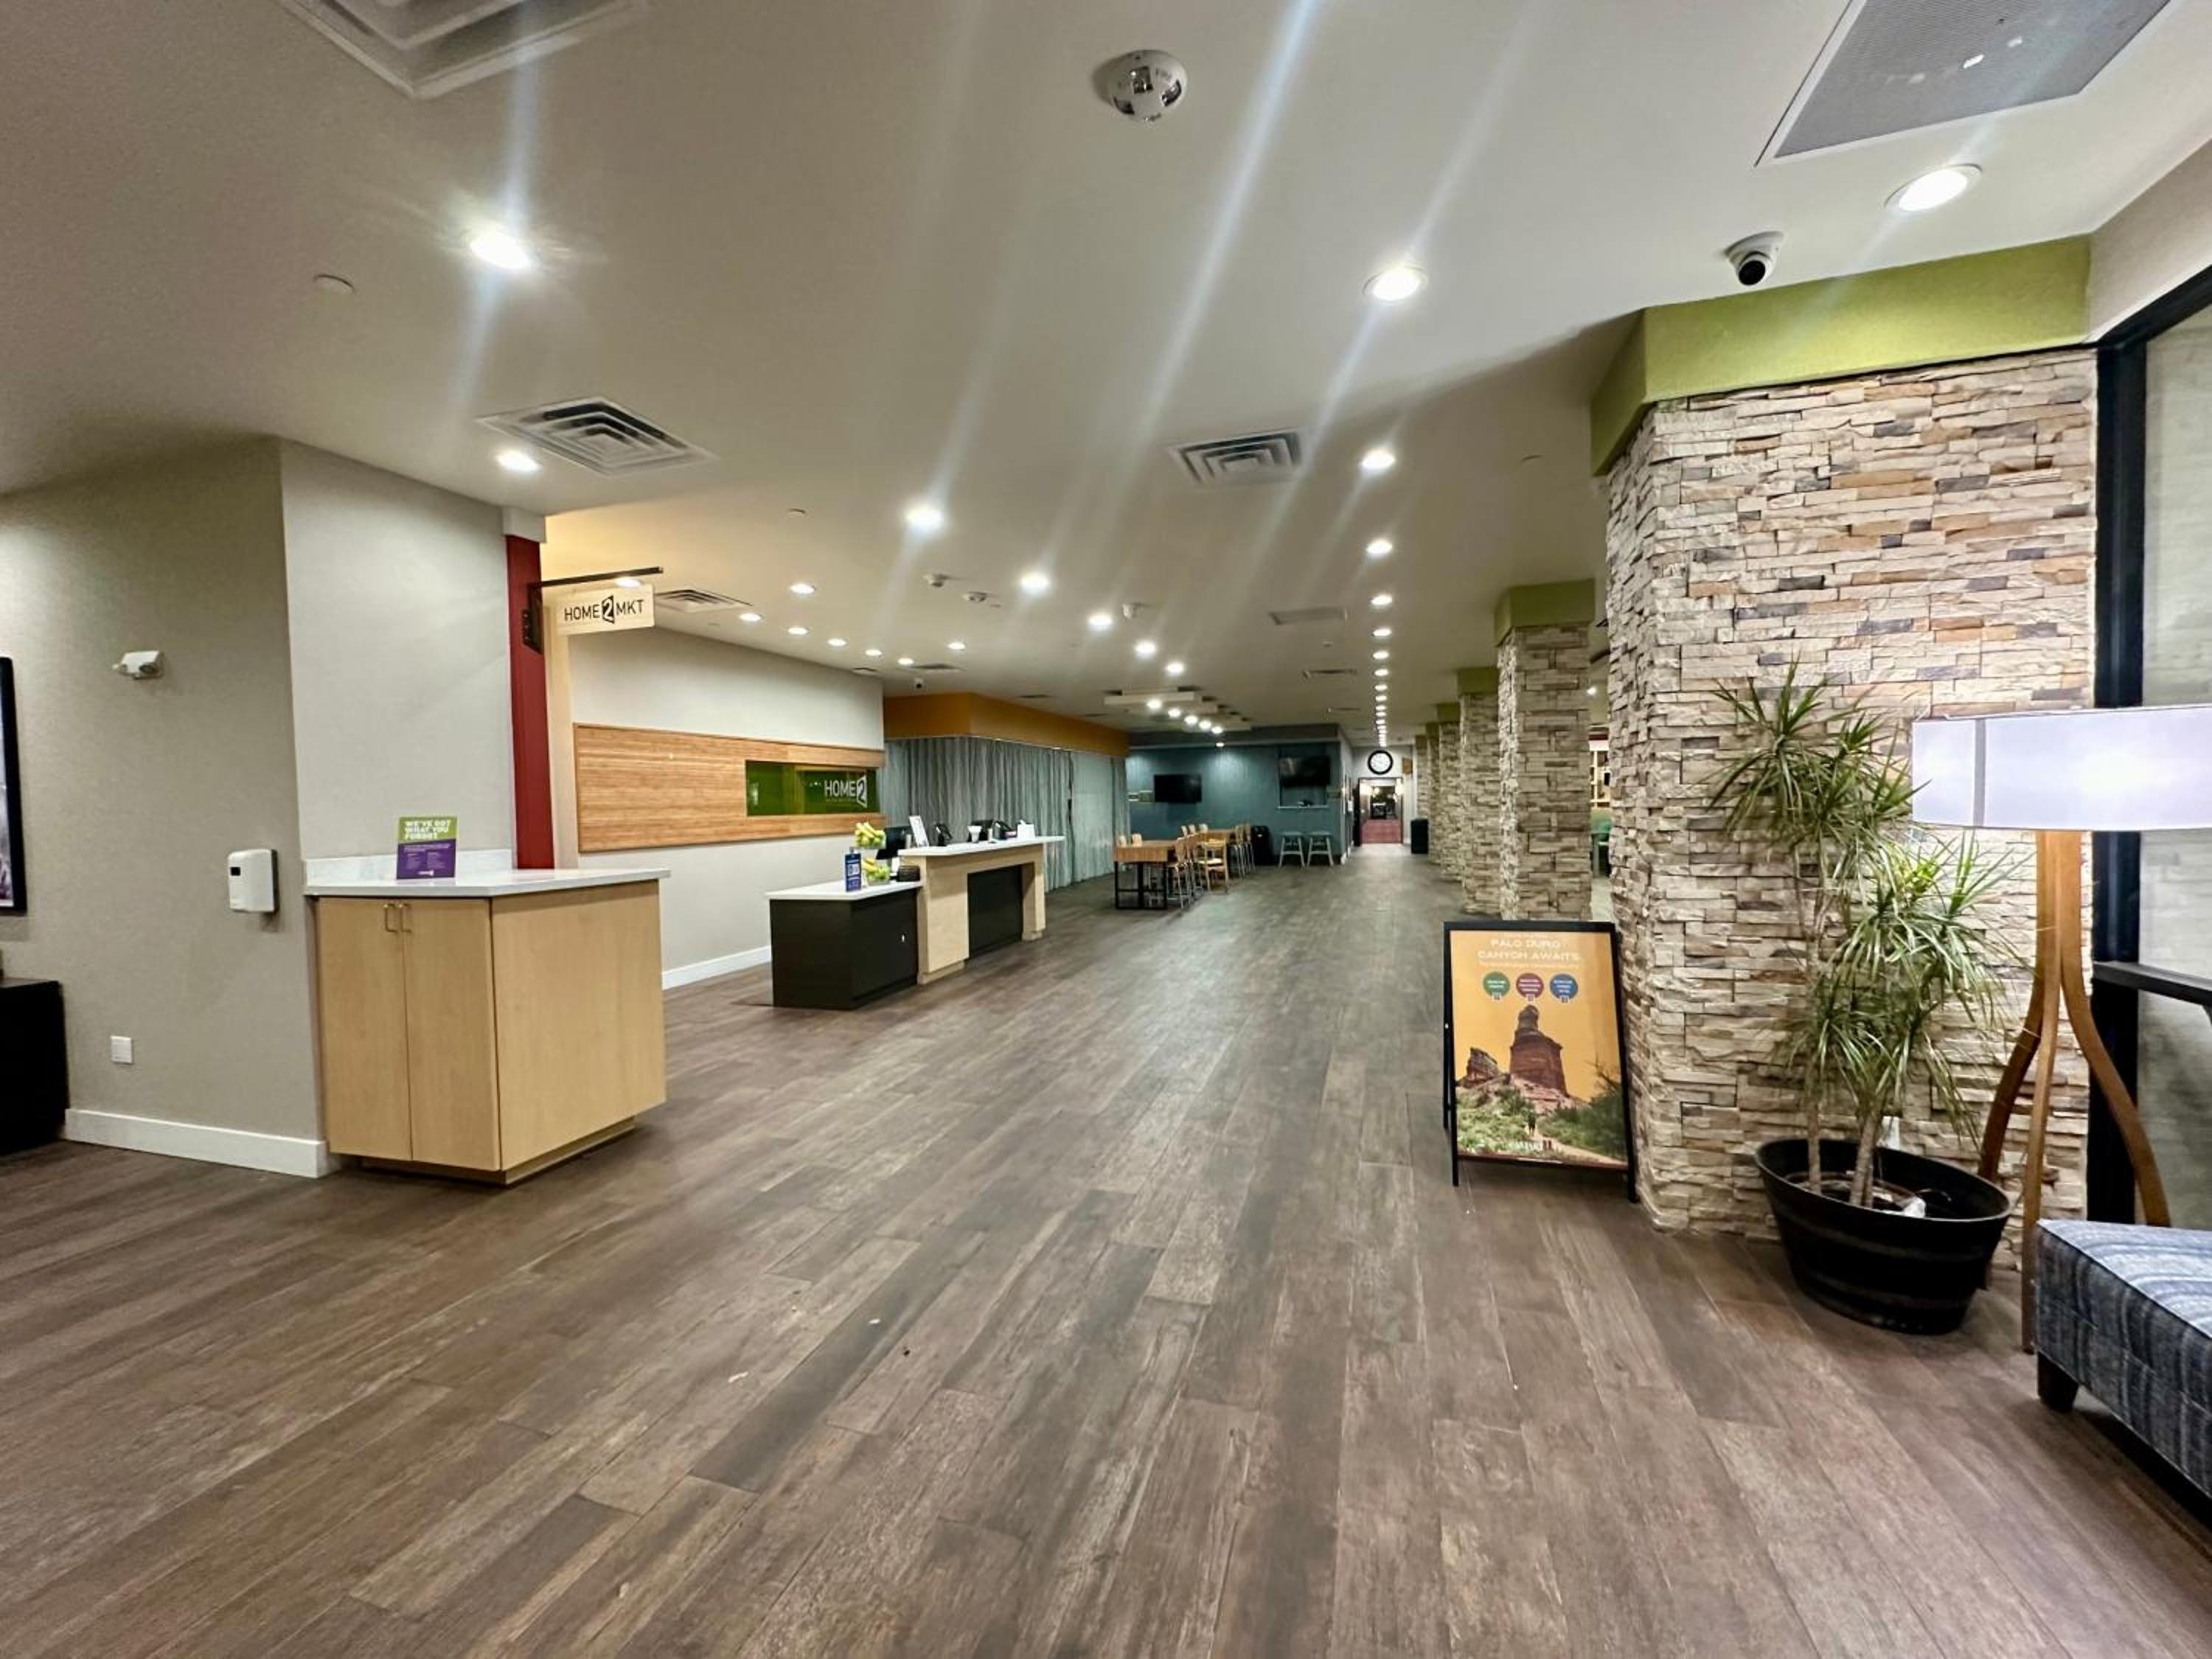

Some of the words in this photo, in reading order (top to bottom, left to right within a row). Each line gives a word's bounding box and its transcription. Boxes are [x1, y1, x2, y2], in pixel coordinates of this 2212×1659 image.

[824, 775, 868, 809] HOME2
[1477, 950, 1528, 959] CANYON
[1531, 951, 1582, 961] AWAITS
